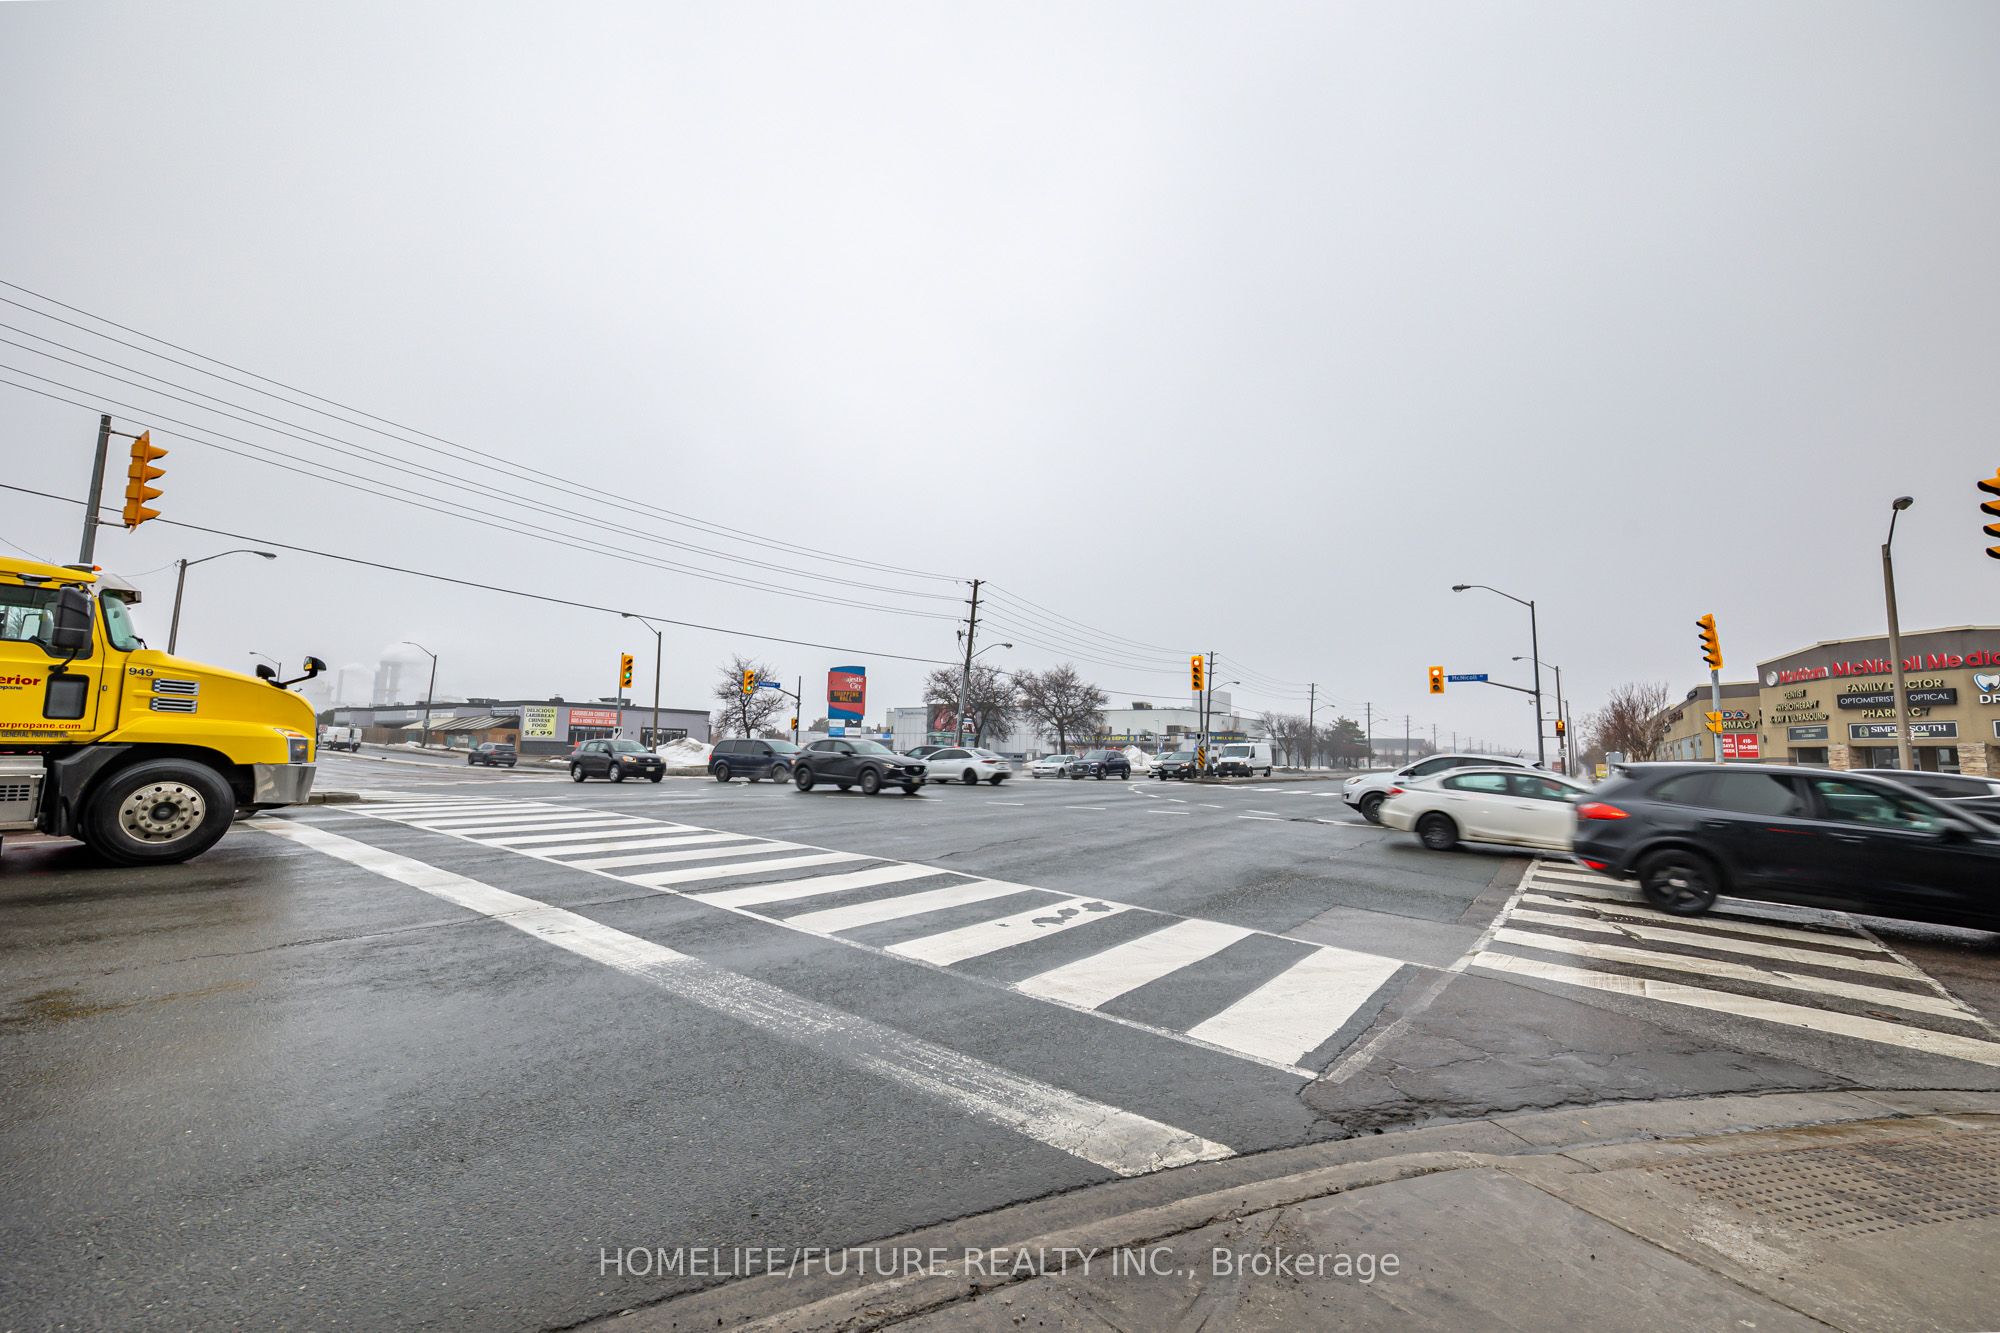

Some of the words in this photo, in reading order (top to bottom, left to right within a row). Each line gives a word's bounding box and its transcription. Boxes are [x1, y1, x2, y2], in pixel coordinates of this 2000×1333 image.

[1832, 656, 1922, 677] McNicoll
[129, 668, 154, 677] 949
[0, 674, 41, 686] erior
[1846, 681, 1885, 692] FAMILY
[1889, 679, 1943, 690] DCTOR
[1784, 690, 1805, 699] DENTIST
[1910, 693, 1950, 702] OPTICAL
[1909, 724, 1946, 732] SOUTH
